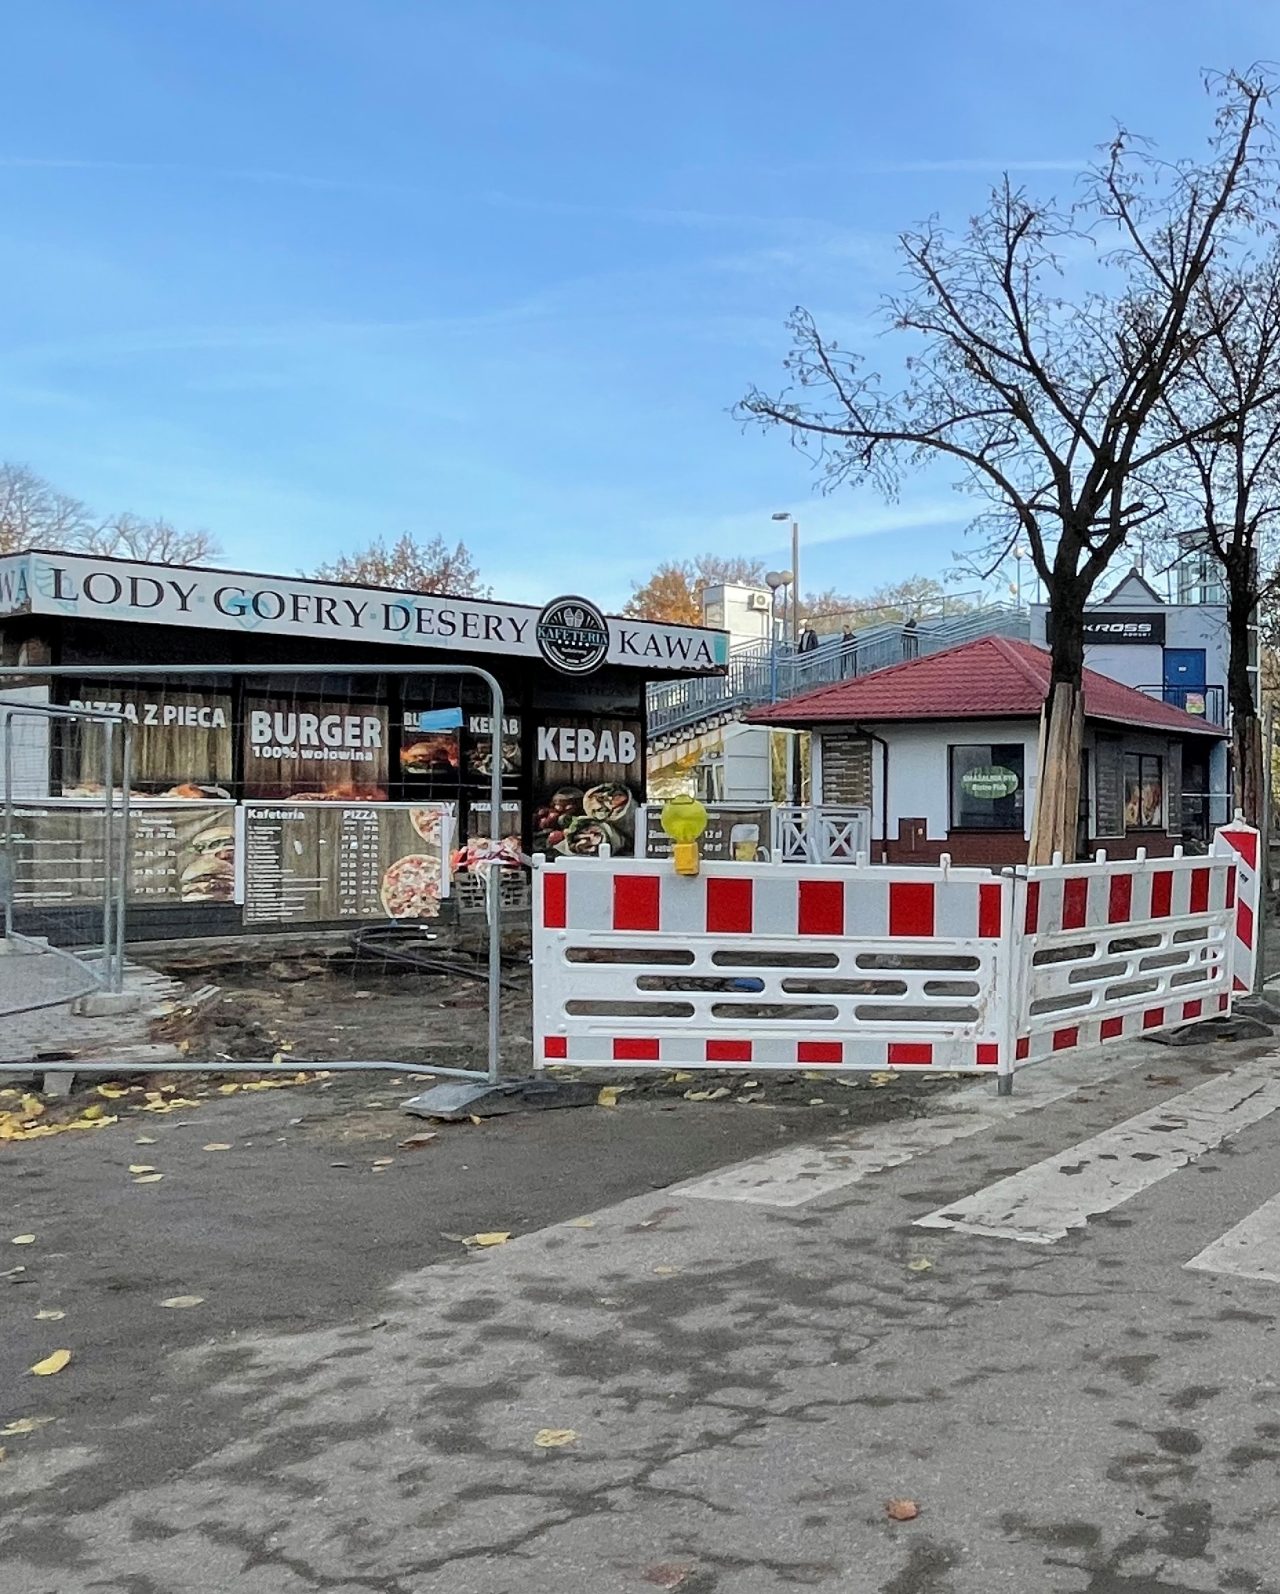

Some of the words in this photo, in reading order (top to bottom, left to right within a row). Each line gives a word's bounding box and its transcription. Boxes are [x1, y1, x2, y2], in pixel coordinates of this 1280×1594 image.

[48, 568, 198, 612] LODY
[213, 586, 369, 628] GOFRY
[381, 603, 529, 643] DESERY
[618, 629, 714, 664] KAWA
[537, 626, 608, 645] KAFETERIA
[1082, 623, 1152, 632] KROSS
[143, 703, 158, 726] Z
[163, 705, 227, 728] PIECA
[251, 710, 383, 748] BURGER
[252, 745, 298, 759] 100%
[537, 726, 636, 764] KEBAB
[247, 808, 306, 820] Kafeteria
[343, 809, 379, 820] PIZZA
